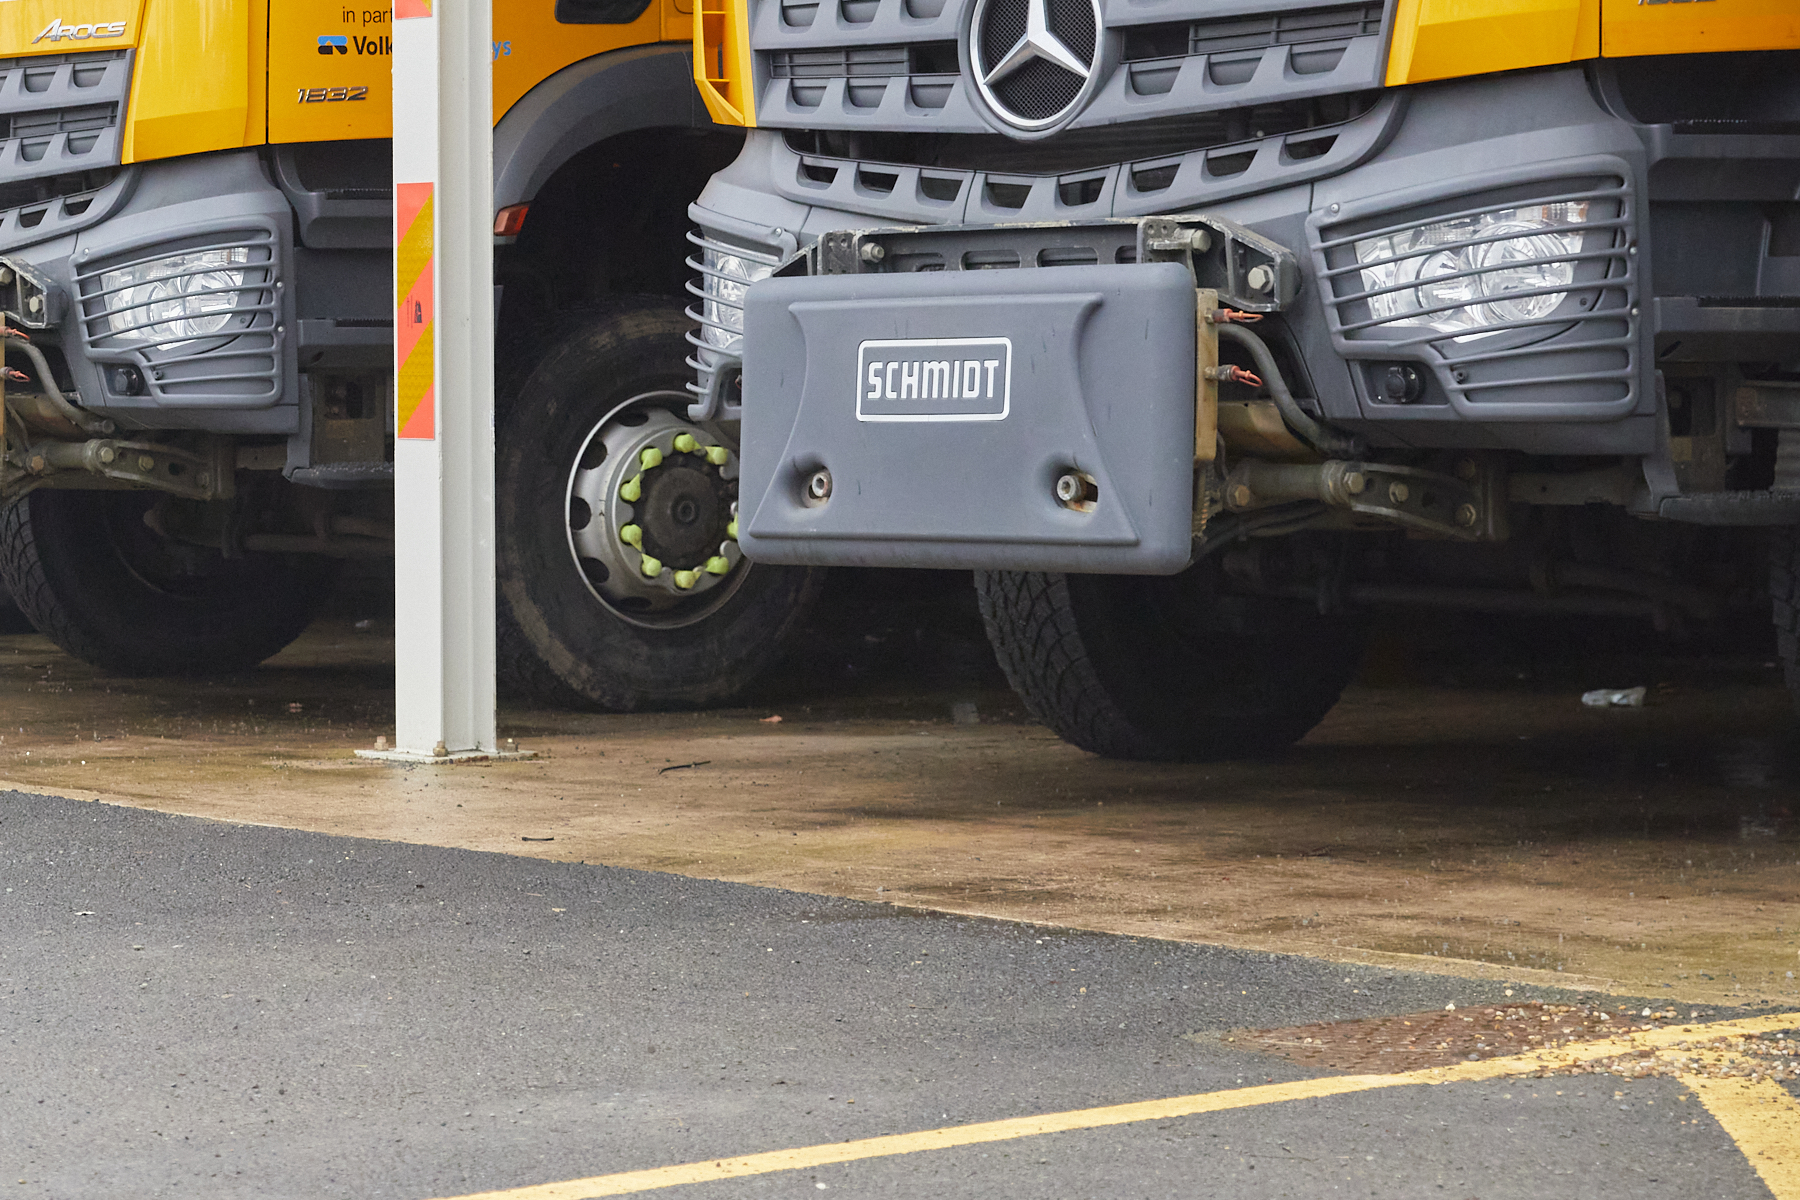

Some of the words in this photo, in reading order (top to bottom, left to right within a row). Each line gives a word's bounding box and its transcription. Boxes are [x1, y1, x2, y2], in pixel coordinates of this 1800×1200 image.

[342, 6, 356, 23] in
[297, 85, 369, 104] 1832
[867, 359, 1000, 399] SCHMIDT
